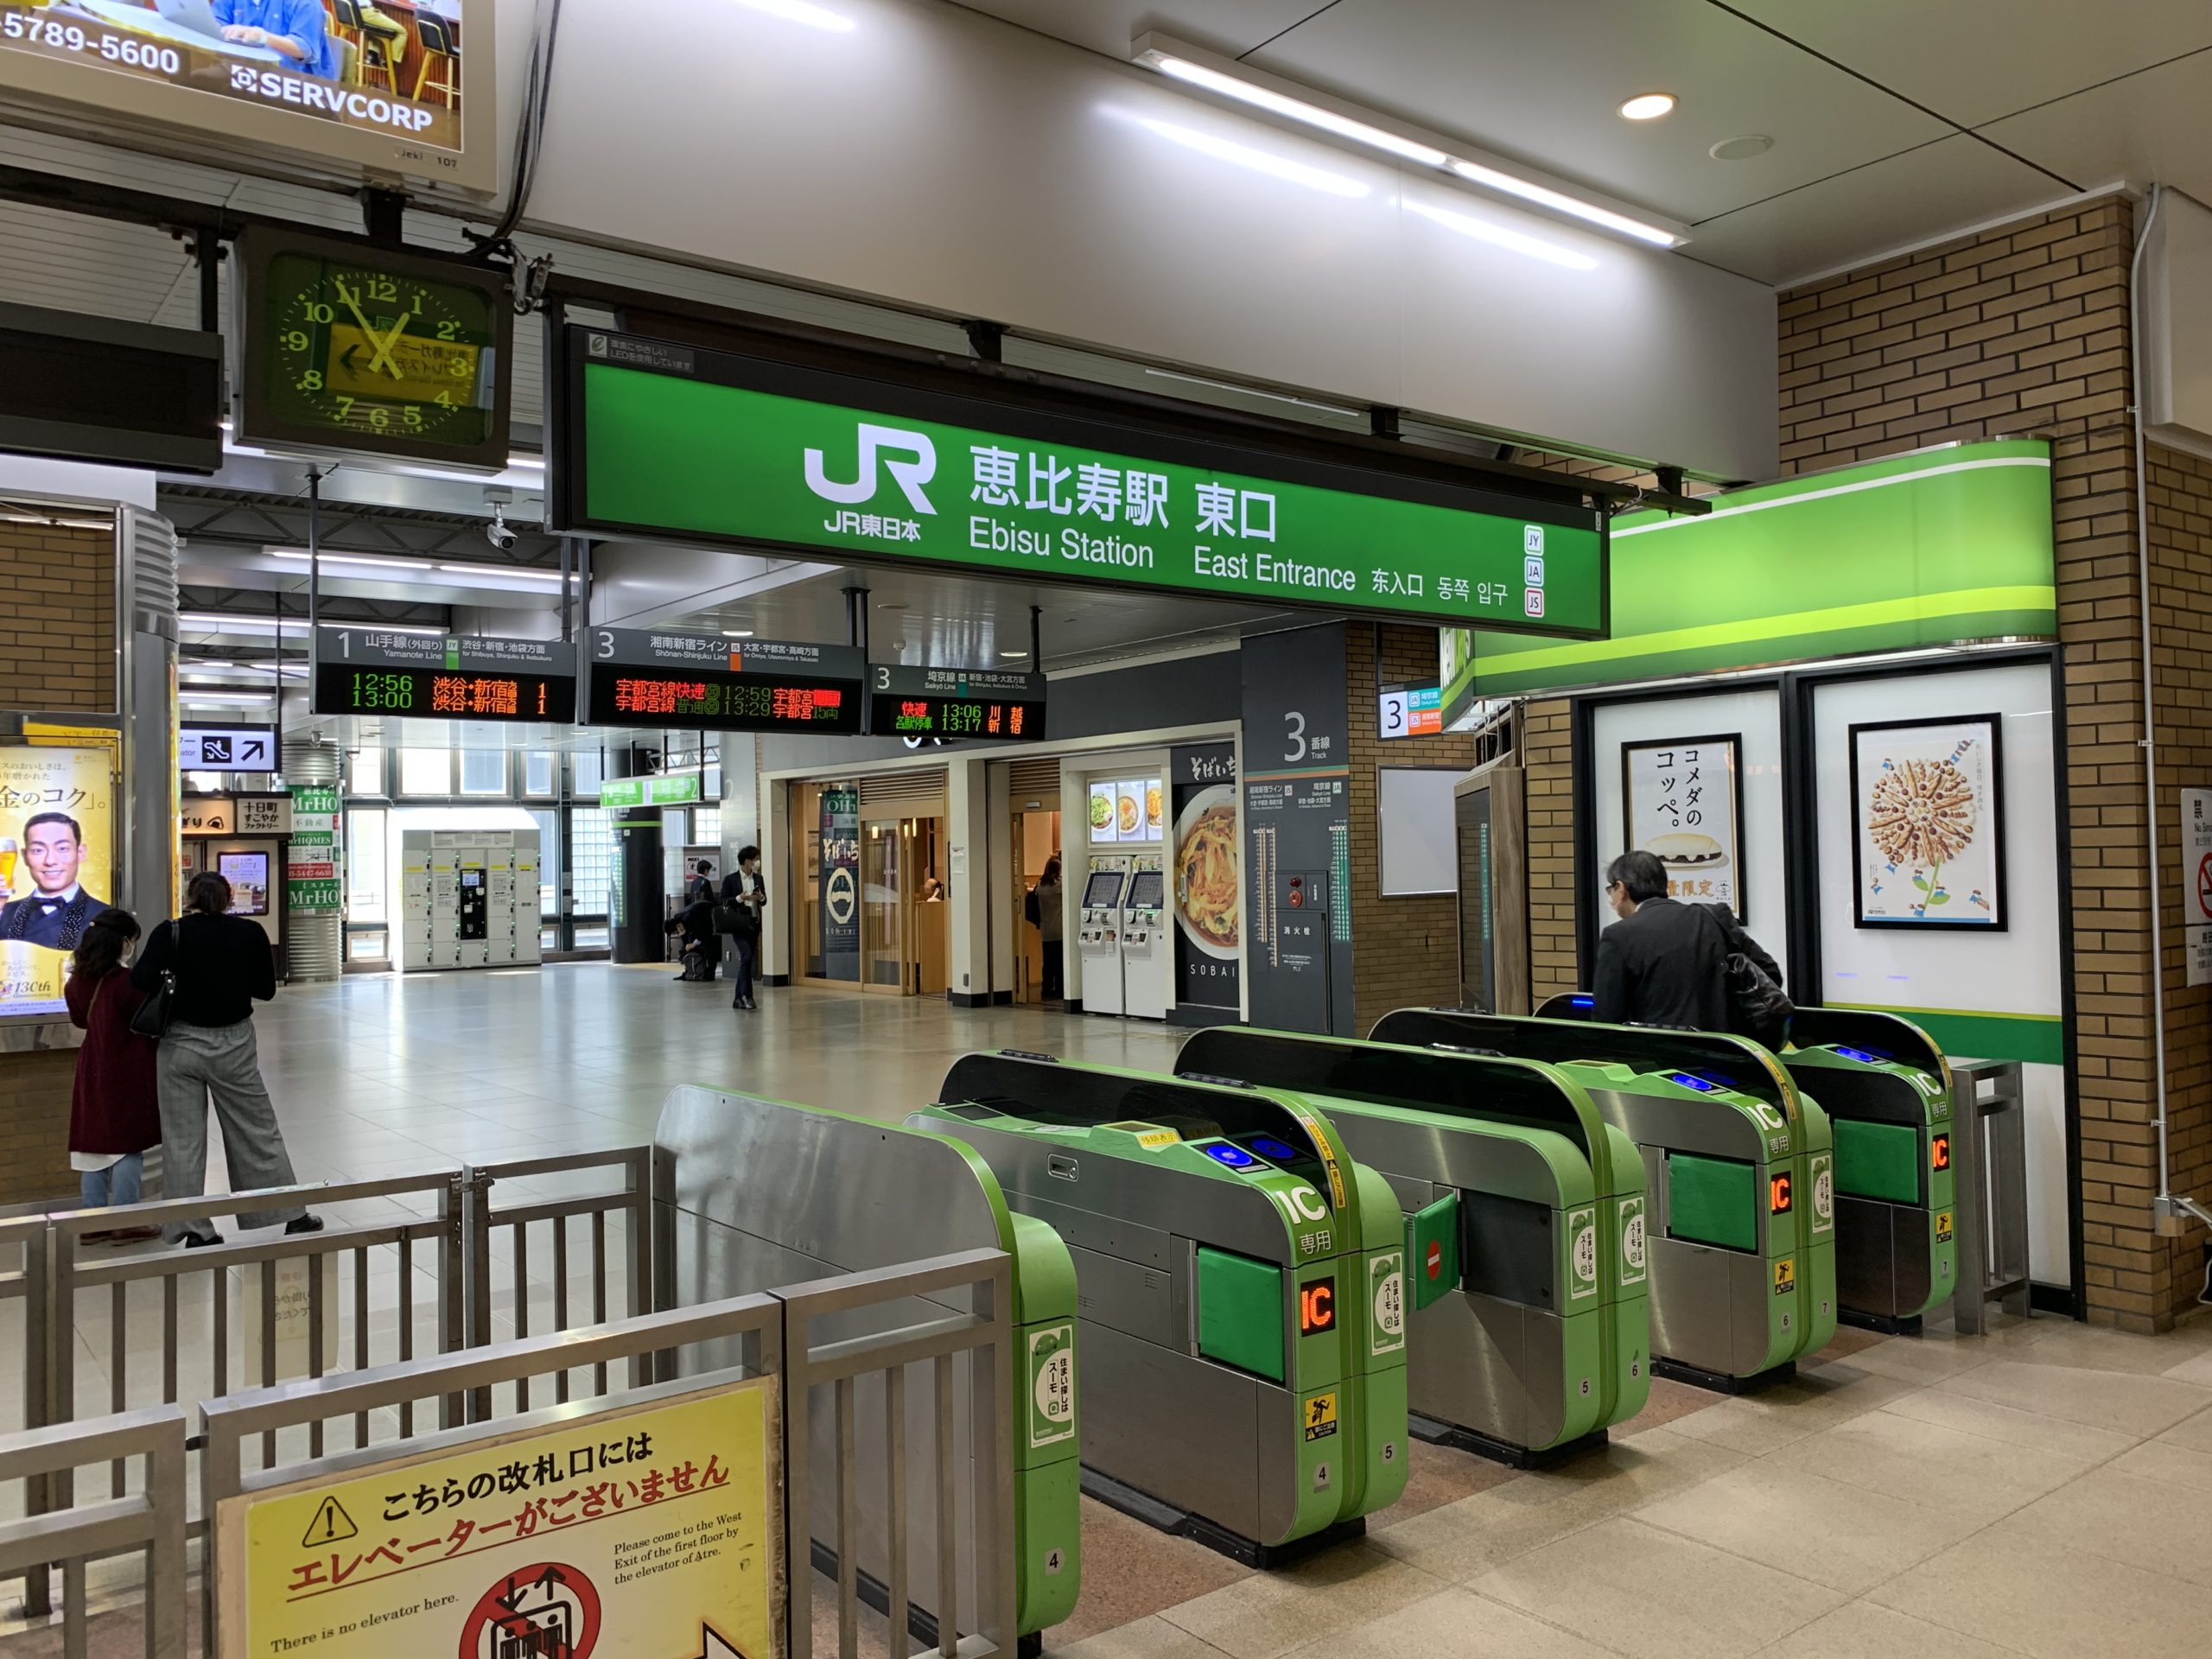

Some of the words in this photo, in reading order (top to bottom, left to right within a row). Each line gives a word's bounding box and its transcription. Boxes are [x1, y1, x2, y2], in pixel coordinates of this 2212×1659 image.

[260, 73, 433, 131] SERVCORP
[437, 156, 457, 168] 107
[367, 280, 397, 302] 12
[304, 302, 334, 323] 10
[410, 296, 423, 315] 1
[436, 321, 455, 340] 2
[288, 331, 309, 352] 9
[449, 358, 468, 377] 3
[302, 370, 323, 390] 8
[336, 396, 355, 416] 7
[434, 391, 452, 409] 4
[370, 408, 389, 428] 6
[403, 405, 423, 425] 5
[804, 422, 938, 516] JR
[969, 445, 1169, 530] 恵比寿駅
[1194, 481, 1276, 543] 東口
[823, 510, 921, 543] JR東日本
[969, 516, 1051, 556] Ebisu
[1061, 528, 1154, 569] Station
[1194, 545, 1248, 580] East
[1256, 553, 1356, 591] Entrance
[1371, 568, 1423, 598] 东入口
[1437, 576, 1470, 603] 동쪽
[1477, 582, 1508, 607] 입구
[338, 632, 350, 658] 1
[365, 633, 443, 652] 山手線(外回り)
[462, 639, 546, 654] 渋谷・新宿・池袋方面
[598, 631, 615, 658] 3
[650, 635, 728, 652] 湘南新宿ライン
[384, 649, 423, 658] Yamanote
[426, 651, 442, 660] Line
[353, 673, 413, 692] 12:56
[877, 667, 890, 690] 3
[927, 671, 956, 683] 埼京線
[538, 682, 546, 698] 1
[615, 678, 706, 700] 宇都宮線快速
[725, 685, 771, 702] 12:59
[353, 690, 412, 709] 13:00
[537, 699, 546, 715] 1
[615, 695, 704, 715] 宇都宮線普通
[724, 700, 771, 716] 13:29
[901, 701, 927, 717] 快速
[942, 703, 982, 718] 13:06
[1388, 700, 1402, 729] 3
[895, 715, 932, 731] 各駅停車
[942, 717, 981, 732] 13:17
[1284, 711, 1306, 762] 3
[1311, 735, 1331, 750] 番線
[1311, 751, 1326, 760] Track
[1656, 751, 1680, 828] コッペ。
[1685, 749, 1702, 826] コメダの
[243, 802, 278, 813] 十日町
[244, 813, 278, 823] すこやか
[296, 818, 324, 827] 不動産
[1667, 879, 1715, 898] 量限定
[1910, 1071, 1942, 1097] IC
[1745, 1103, 1783, 1131] IC
[1931, 1101, 1948, 1118] 専用
[1770, 1135, 1789, 1154] 専用
[1933, 1139, 1948, 1168] IC
[1276, 1185, 1326, 1224] IC
[1770, 1178, 1789, 1211] IC
[1300, 1230, 1332, 1255] 専用
[1301, 1286, 1332, 1330] IC
[1822, 1302, 1827, 1313] 7
[1783, 1314, 1789, 1326] 6
[1631, 1364, 1638, 1377] 6
[1059, 1357, 1069, 1413] 住まい探しは
[1582, 1381, 1588, 1394] 5
[1385, 1445, 1393, 1460] 5
[382, 1431, 653, 1522] こちらの改札口には
[1319, 1465, 1326, 1480] 4
[288, 1454, 730, 1592] エレベーターがございません
[614, 1537, 650, 1555] Please
[652, 1529, 681, 1544] come
[683, 1525, 694, 1535] to
[696, 1519, 714, 1532] the
[716, 1511, 743, 1526] West
[614, 1554, 639, 1570] Exit
[640, 1549, 652, 1562] of
[654, 1546, 671, 1559] the
[674, 1538, 698, 1553] first
[700, 1532, 724, 1546] floor
[727, 1527, 740, 1539] by
[614, 1572, 633, 1585] the
[635, 1559, 680, 1579] elevator
[682, 1553, 693, 1565] of
[695, 1548, 721, 1562] Atre.
[1049, 1552, 1058, 1568] 4
[270, 1631, 317, 1654] There
[321, 1627, 334, 1640] is
[339, 1622, 357, 1635] no
[360, 1603, 421, 1629] elevator
[423, 1592, 460, 1612] here.
